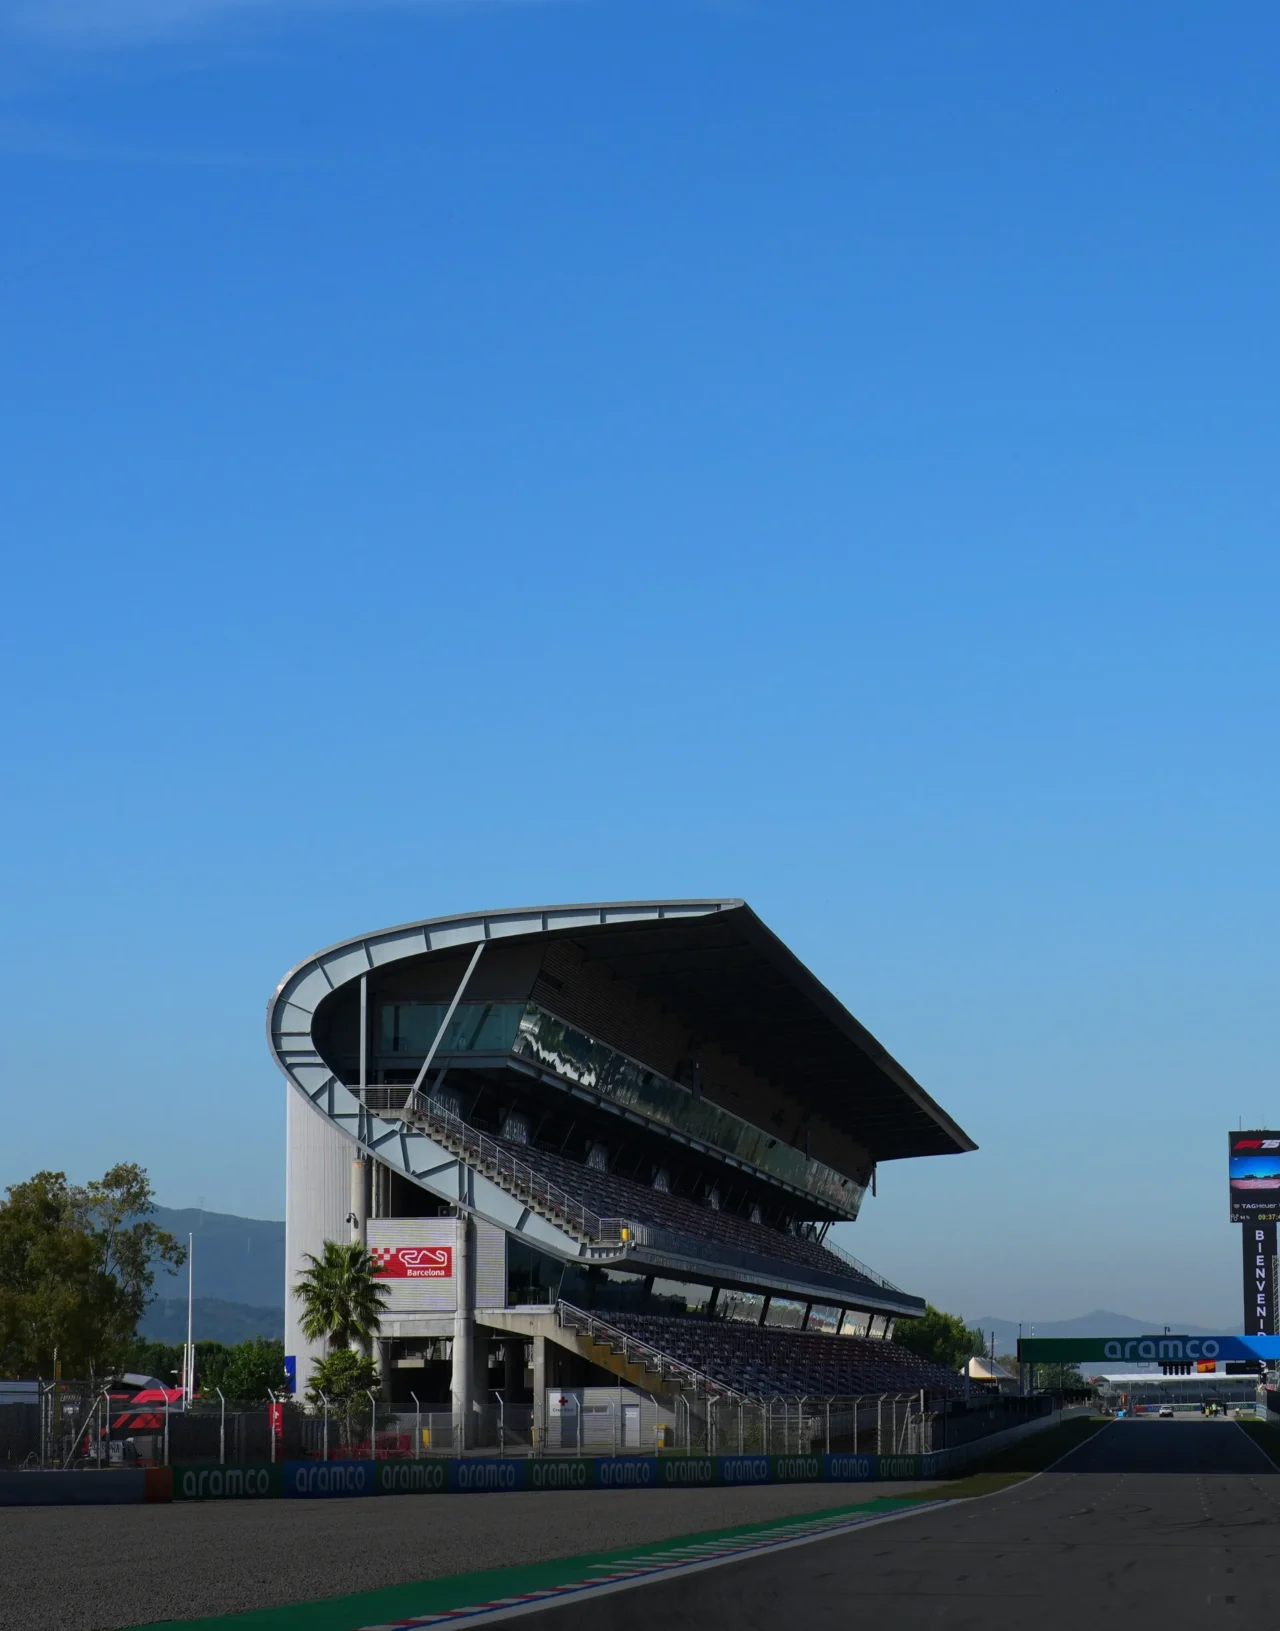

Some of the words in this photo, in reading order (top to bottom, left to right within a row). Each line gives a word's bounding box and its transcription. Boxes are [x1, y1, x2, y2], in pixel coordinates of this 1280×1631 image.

[407, 1268, 445, 1276] Barcelona
[1104, 1339, 1220, 1359] aramco
[382, 1463, 443, 1489] aramco
[458, 1463, 515, 1488] aramco
[532, 1463, 586, 1486] aramco
[600, 1462, 650, 1484] aramco
[666, 1460, 712, 1481] aramco
[724, 1459, 768, 1480] aramco
[777, 1458, 818, 1478] aramco
[831, 1457, 869, 1478] aramco
[879, 1457, 915, 1477] aramco
[183, 1468, 270, 1497] aramco
[295, 1465, 365, 1492] aramco
